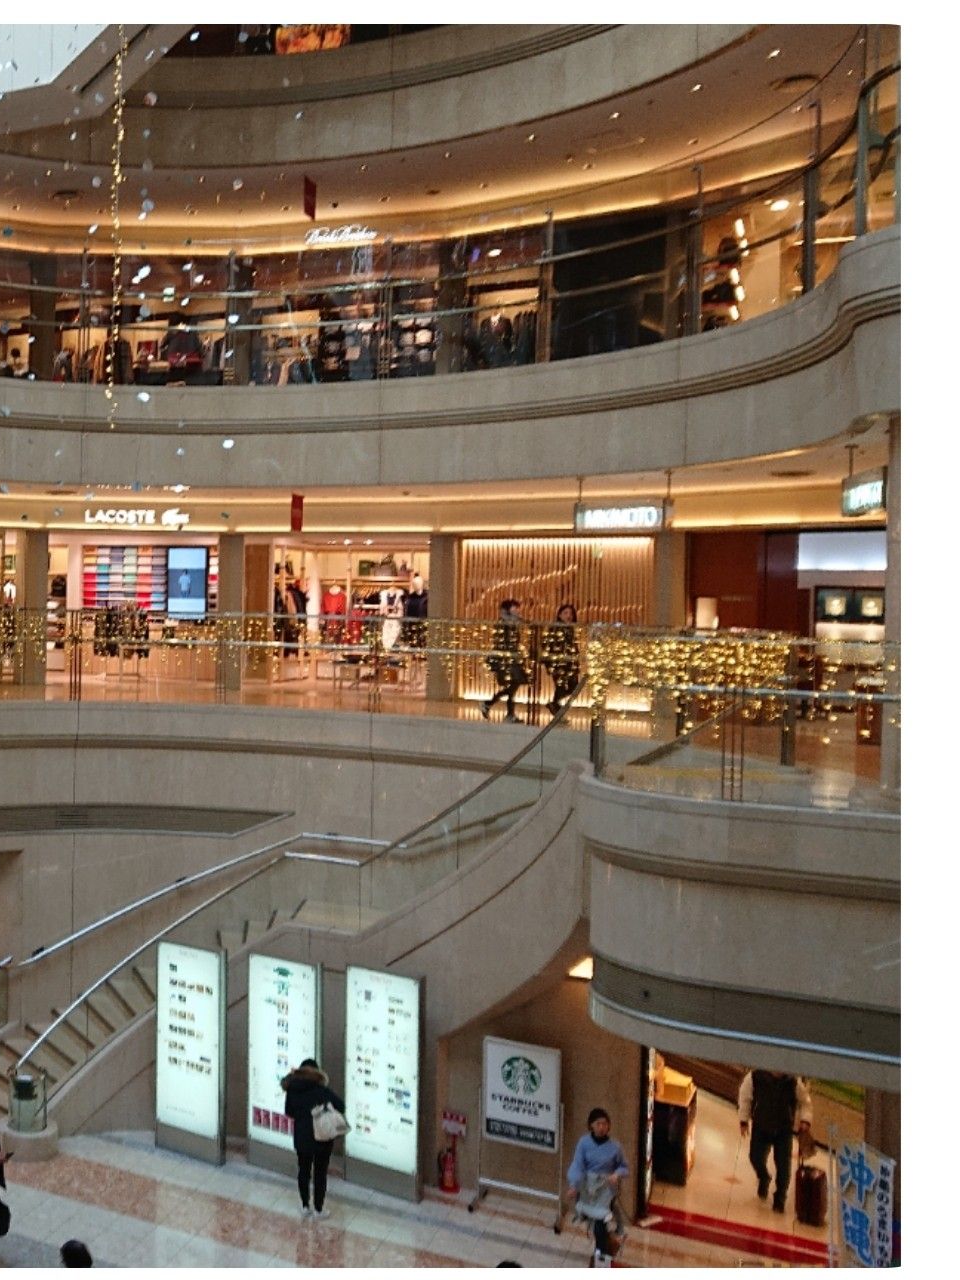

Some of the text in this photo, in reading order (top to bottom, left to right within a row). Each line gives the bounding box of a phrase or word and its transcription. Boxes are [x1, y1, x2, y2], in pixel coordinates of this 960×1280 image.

[84, 509, 156, 525] LACOSTE
[491, 1093, 551, 1112] STARBUCKS
[502, 1103, 539, 1117] COFFEE
